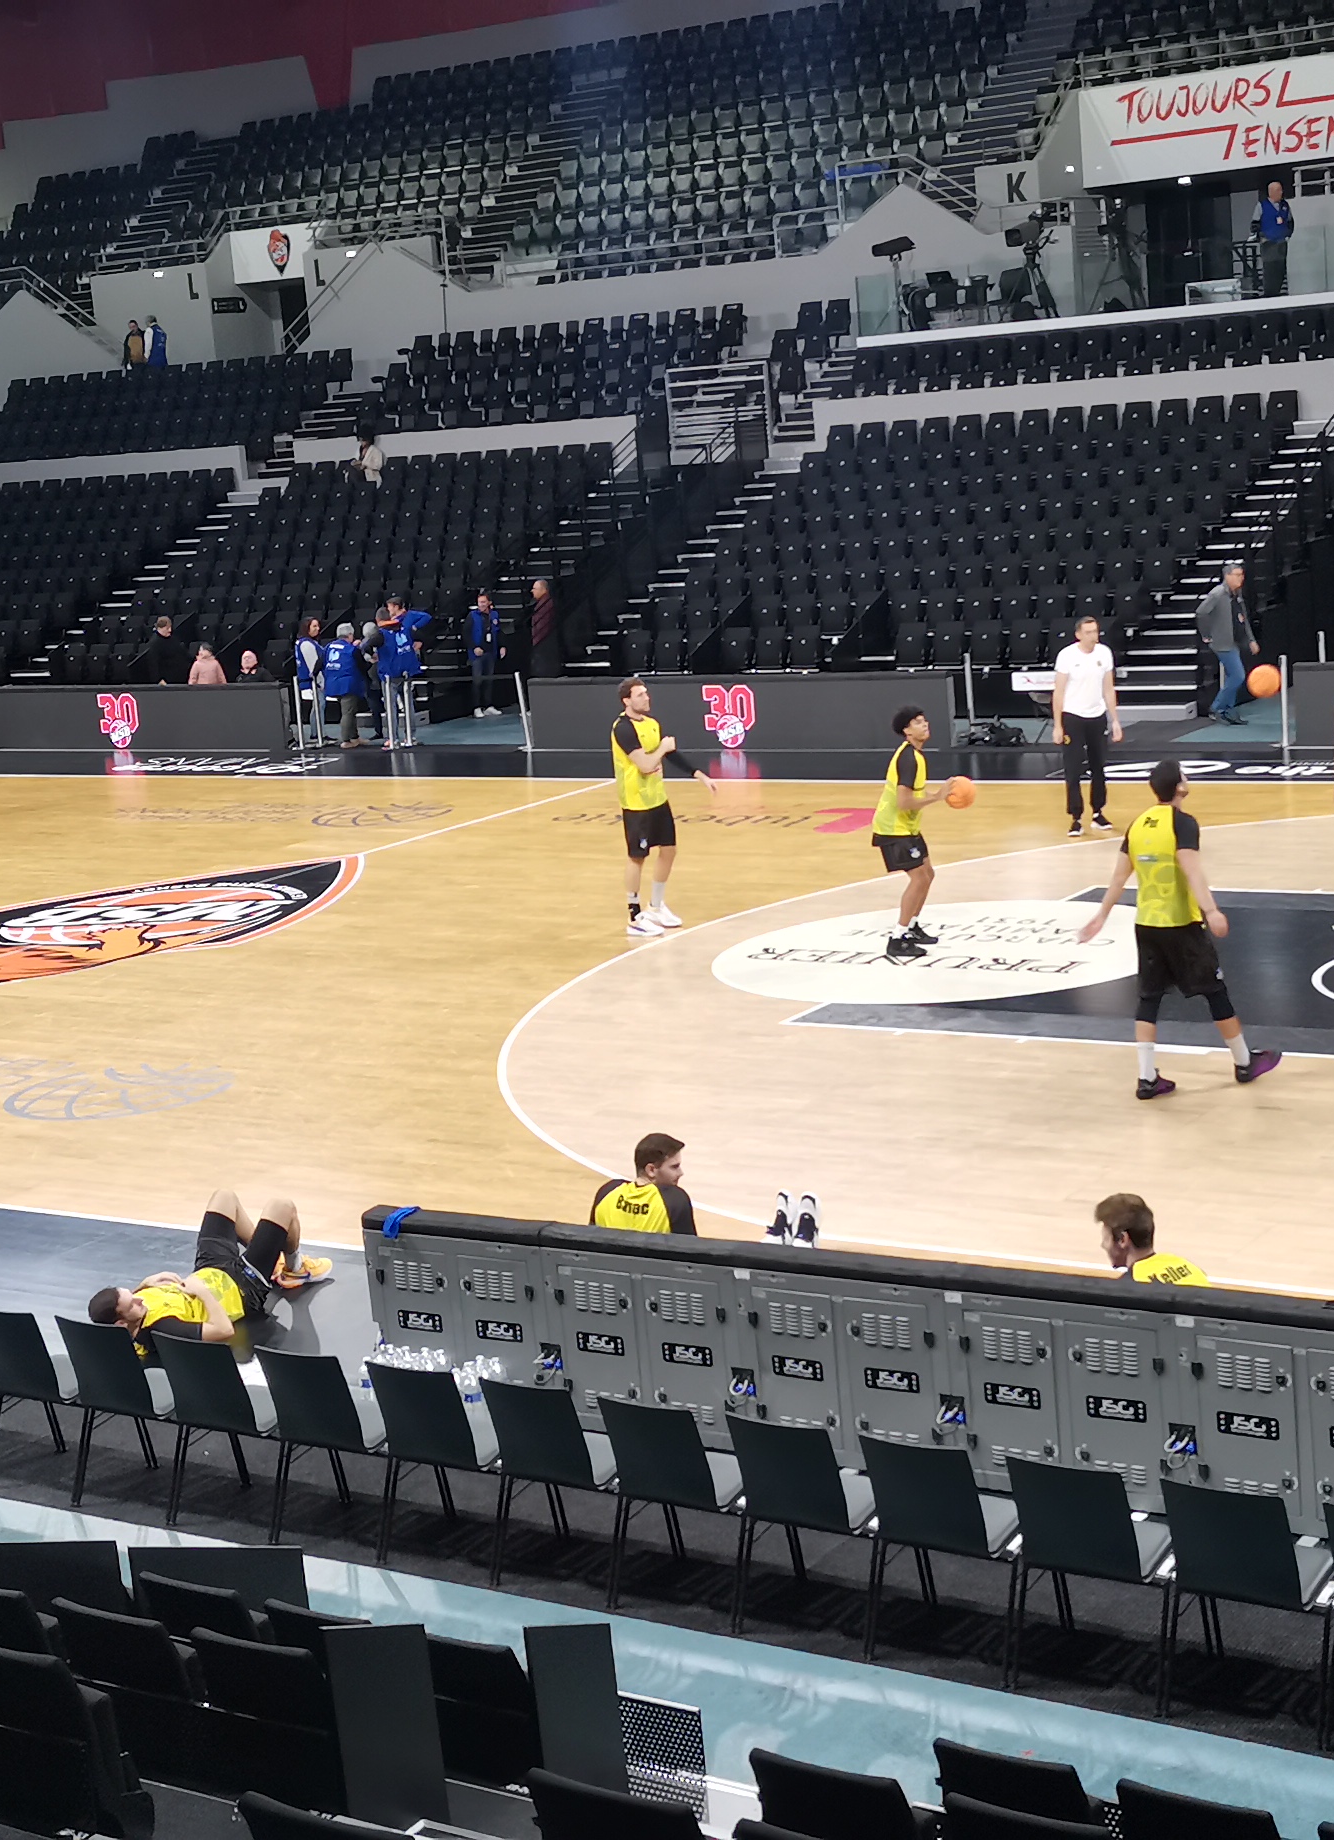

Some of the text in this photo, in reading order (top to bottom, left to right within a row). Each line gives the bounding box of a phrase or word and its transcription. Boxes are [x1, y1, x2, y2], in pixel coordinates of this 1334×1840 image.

[1117, 68, 1275, 127] TOUJOURS
[1007, 170, 1027, 203] K
[187, 273, 199, 300] L
[314, 259, 326, 287] L
[97, 692, 140, 734] 30
[702, 684, 756, 731] 30
[552, 811, 812, 829] lubekie
[848, 929, 1115, 947] CHARCURIE
[747, 946, 1091, 975] PRUNIER
